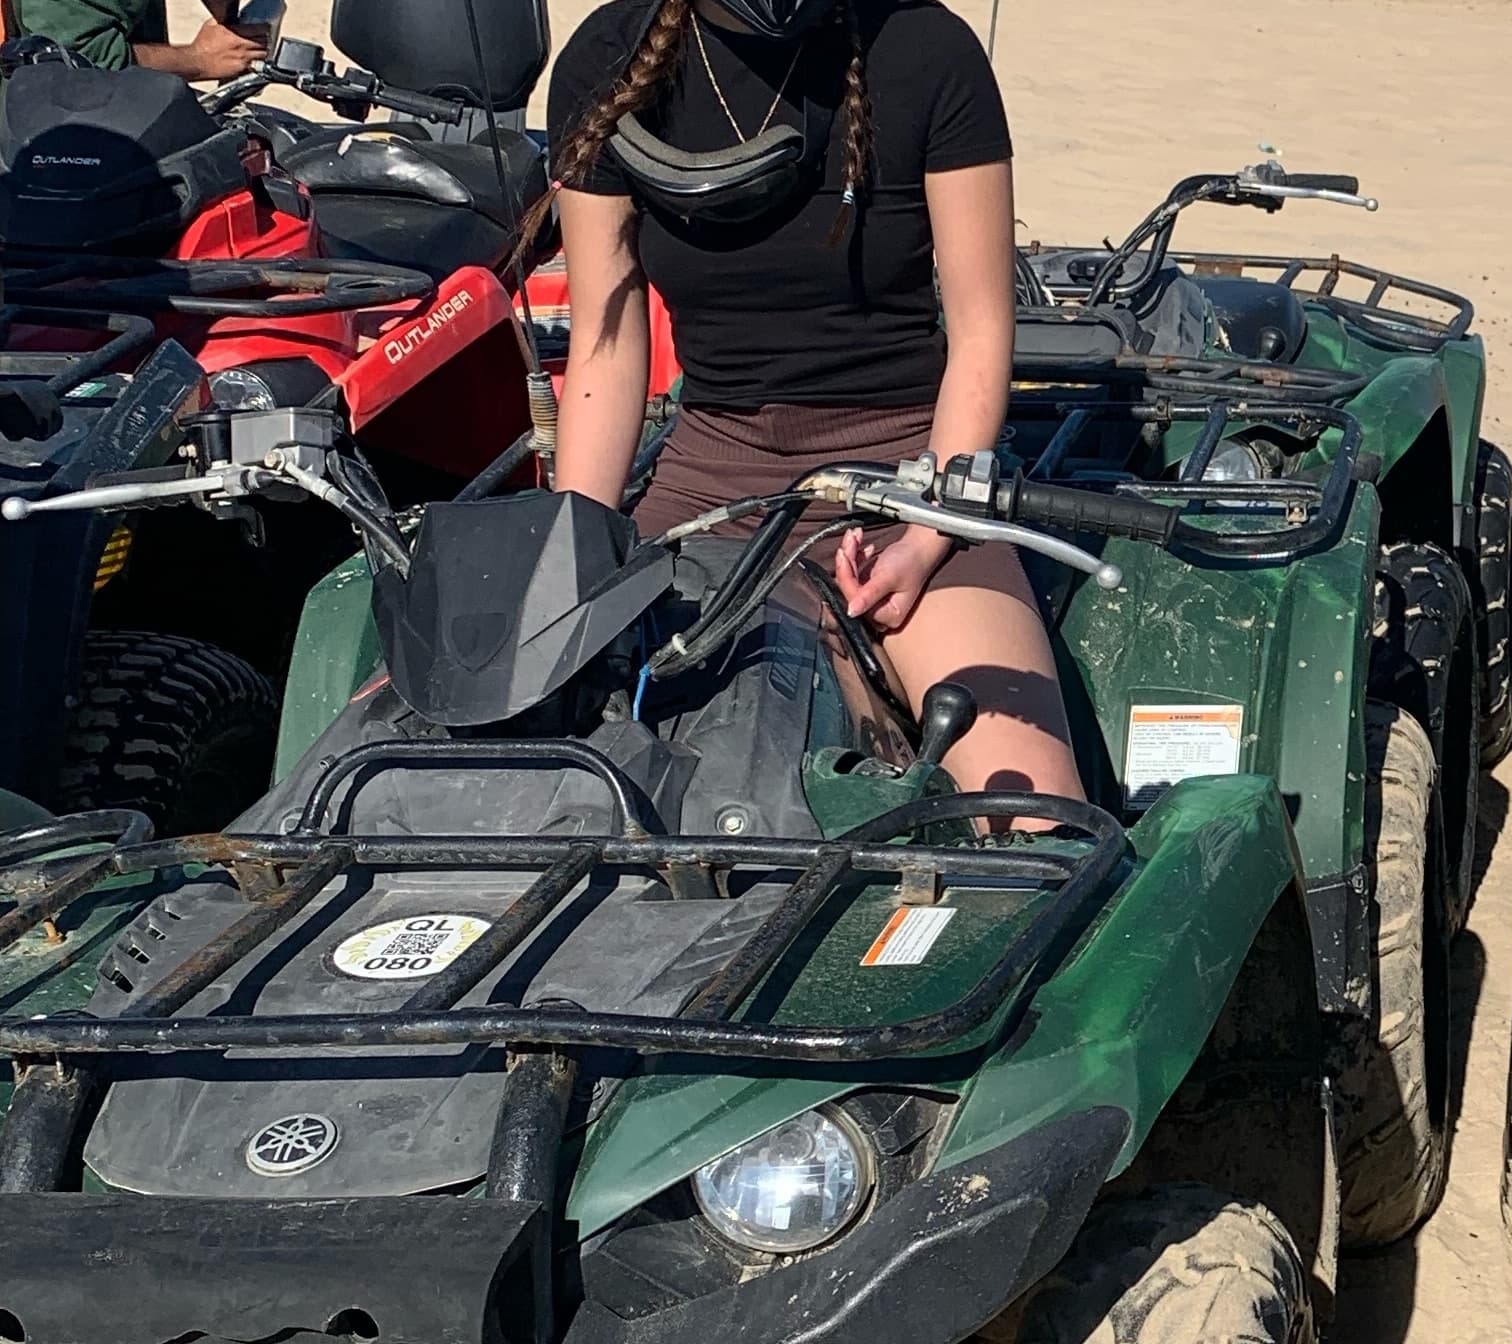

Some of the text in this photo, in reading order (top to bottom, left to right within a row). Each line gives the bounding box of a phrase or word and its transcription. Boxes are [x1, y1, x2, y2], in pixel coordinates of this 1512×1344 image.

[32, 155, 101, 166] OUTLANDER
[384, 290, 473, 365] OUTLANDER
[405, 919, 454, 932] QL
[363, 957, 432, 970] 080
